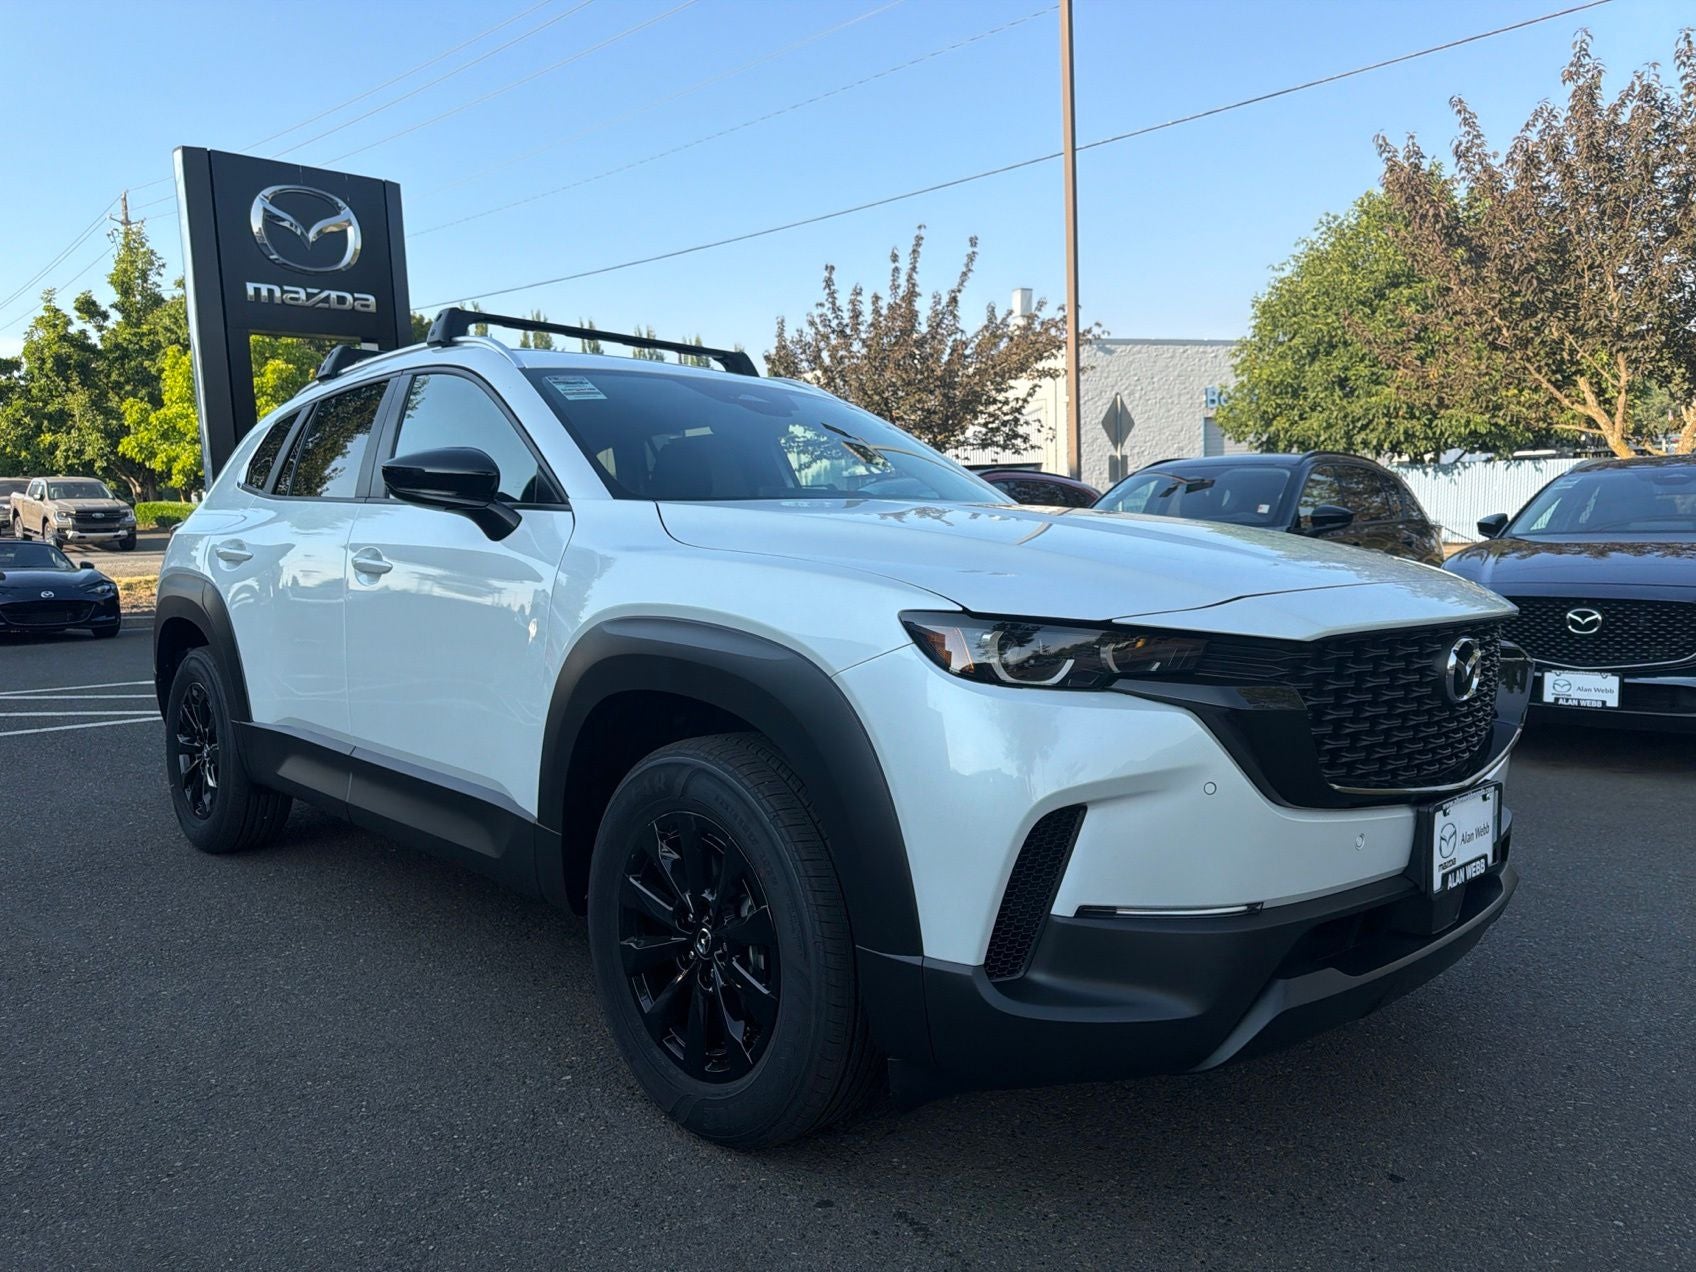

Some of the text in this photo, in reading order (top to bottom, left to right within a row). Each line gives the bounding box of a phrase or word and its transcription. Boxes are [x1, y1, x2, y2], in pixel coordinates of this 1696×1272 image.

[246, 281, 377, 313] mazda
[1558, 698, 1602, 708] ALAN WEBB
[1460, 822, 1490, 845] Alan Webb
[1447, 858, 1486, 890] ALAN WEBB
